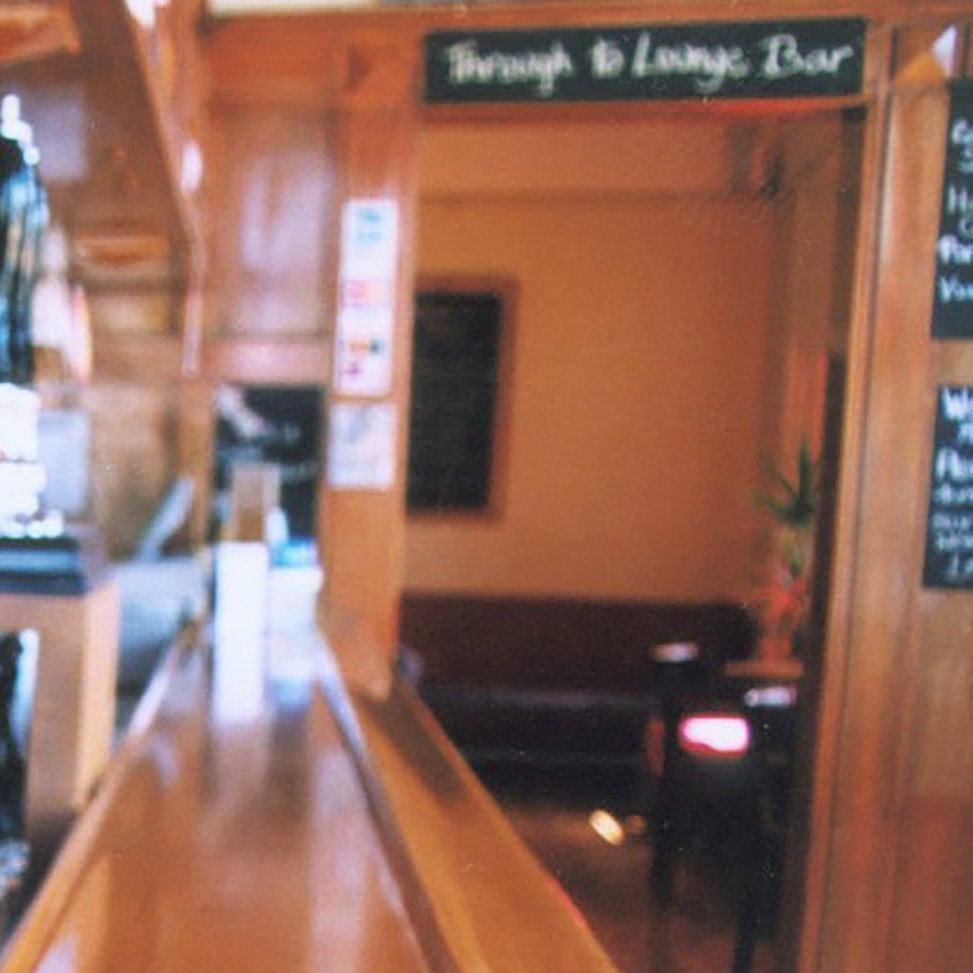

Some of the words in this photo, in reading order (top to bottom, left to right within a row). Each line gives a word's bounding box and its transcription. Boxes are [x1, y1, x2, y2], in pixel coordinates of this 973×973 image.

[446, 39, 573, 97] Through
[590, 37, 625, 78] to
[632, 32, 749, 92] Lounge
[761, 33, 855, 78] Bar
